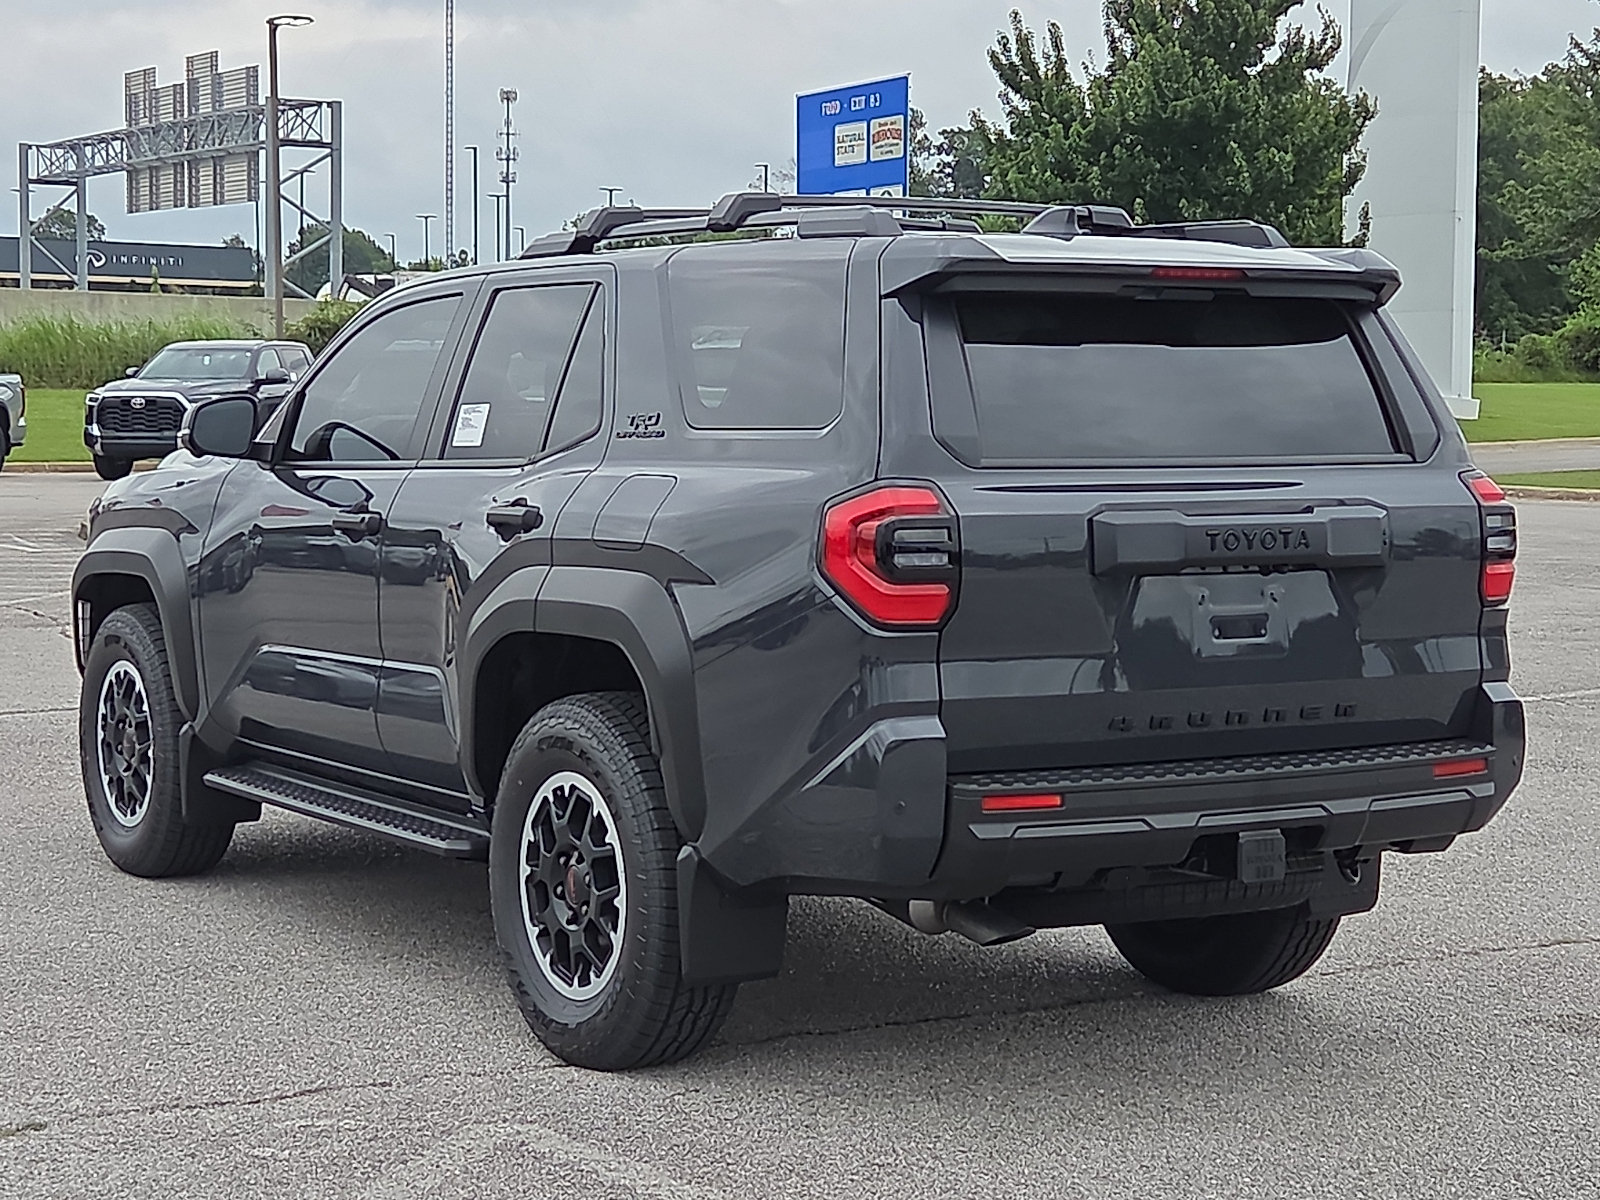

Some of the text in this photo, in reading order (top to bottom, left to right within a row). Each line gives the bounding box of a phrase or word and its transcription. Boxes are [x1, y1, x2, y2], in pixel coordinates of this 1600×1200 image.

[111, 254, 184, 267] INFINITI
[1205, 527, 1311, 553] TOYOTA
[1107, 703, 1359, 732] 4RUNNER
